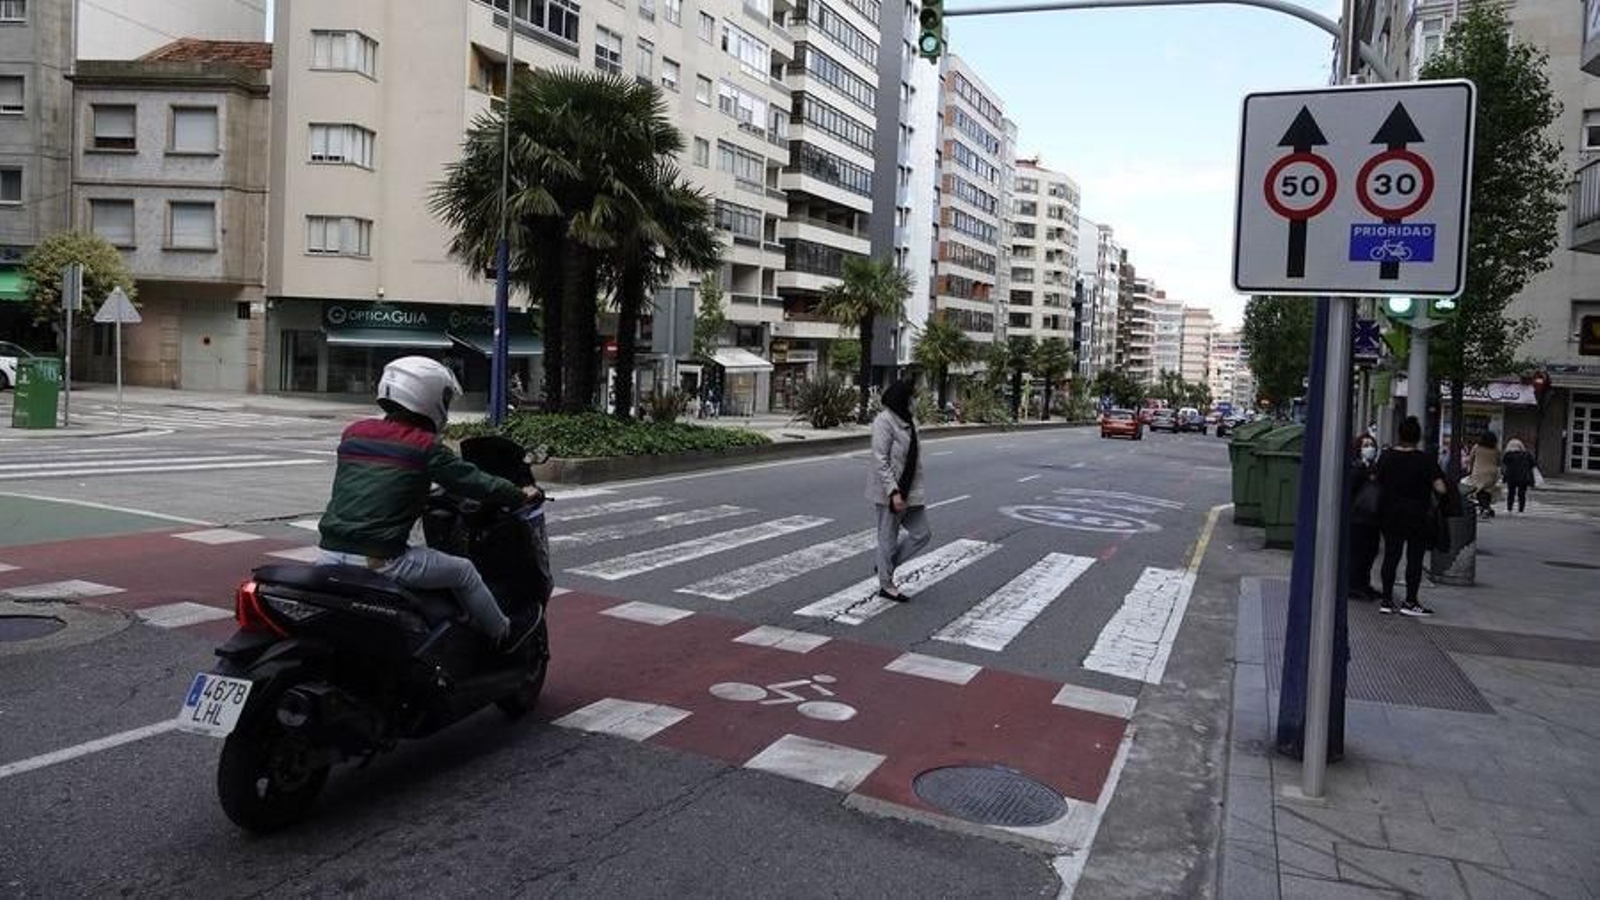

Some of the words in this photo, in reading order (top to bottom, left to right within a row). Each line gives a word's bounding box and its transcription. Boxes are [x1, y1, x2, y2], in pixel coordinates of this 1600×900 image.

[1281, 175, 1320, 197] 50
[1373, 173, 1416, 196] 30
[1353, 226, 1432, 237] PRIORIDAD
[204, 679, 247, 704] 4678
[193, 701, 222, 726] LHL
